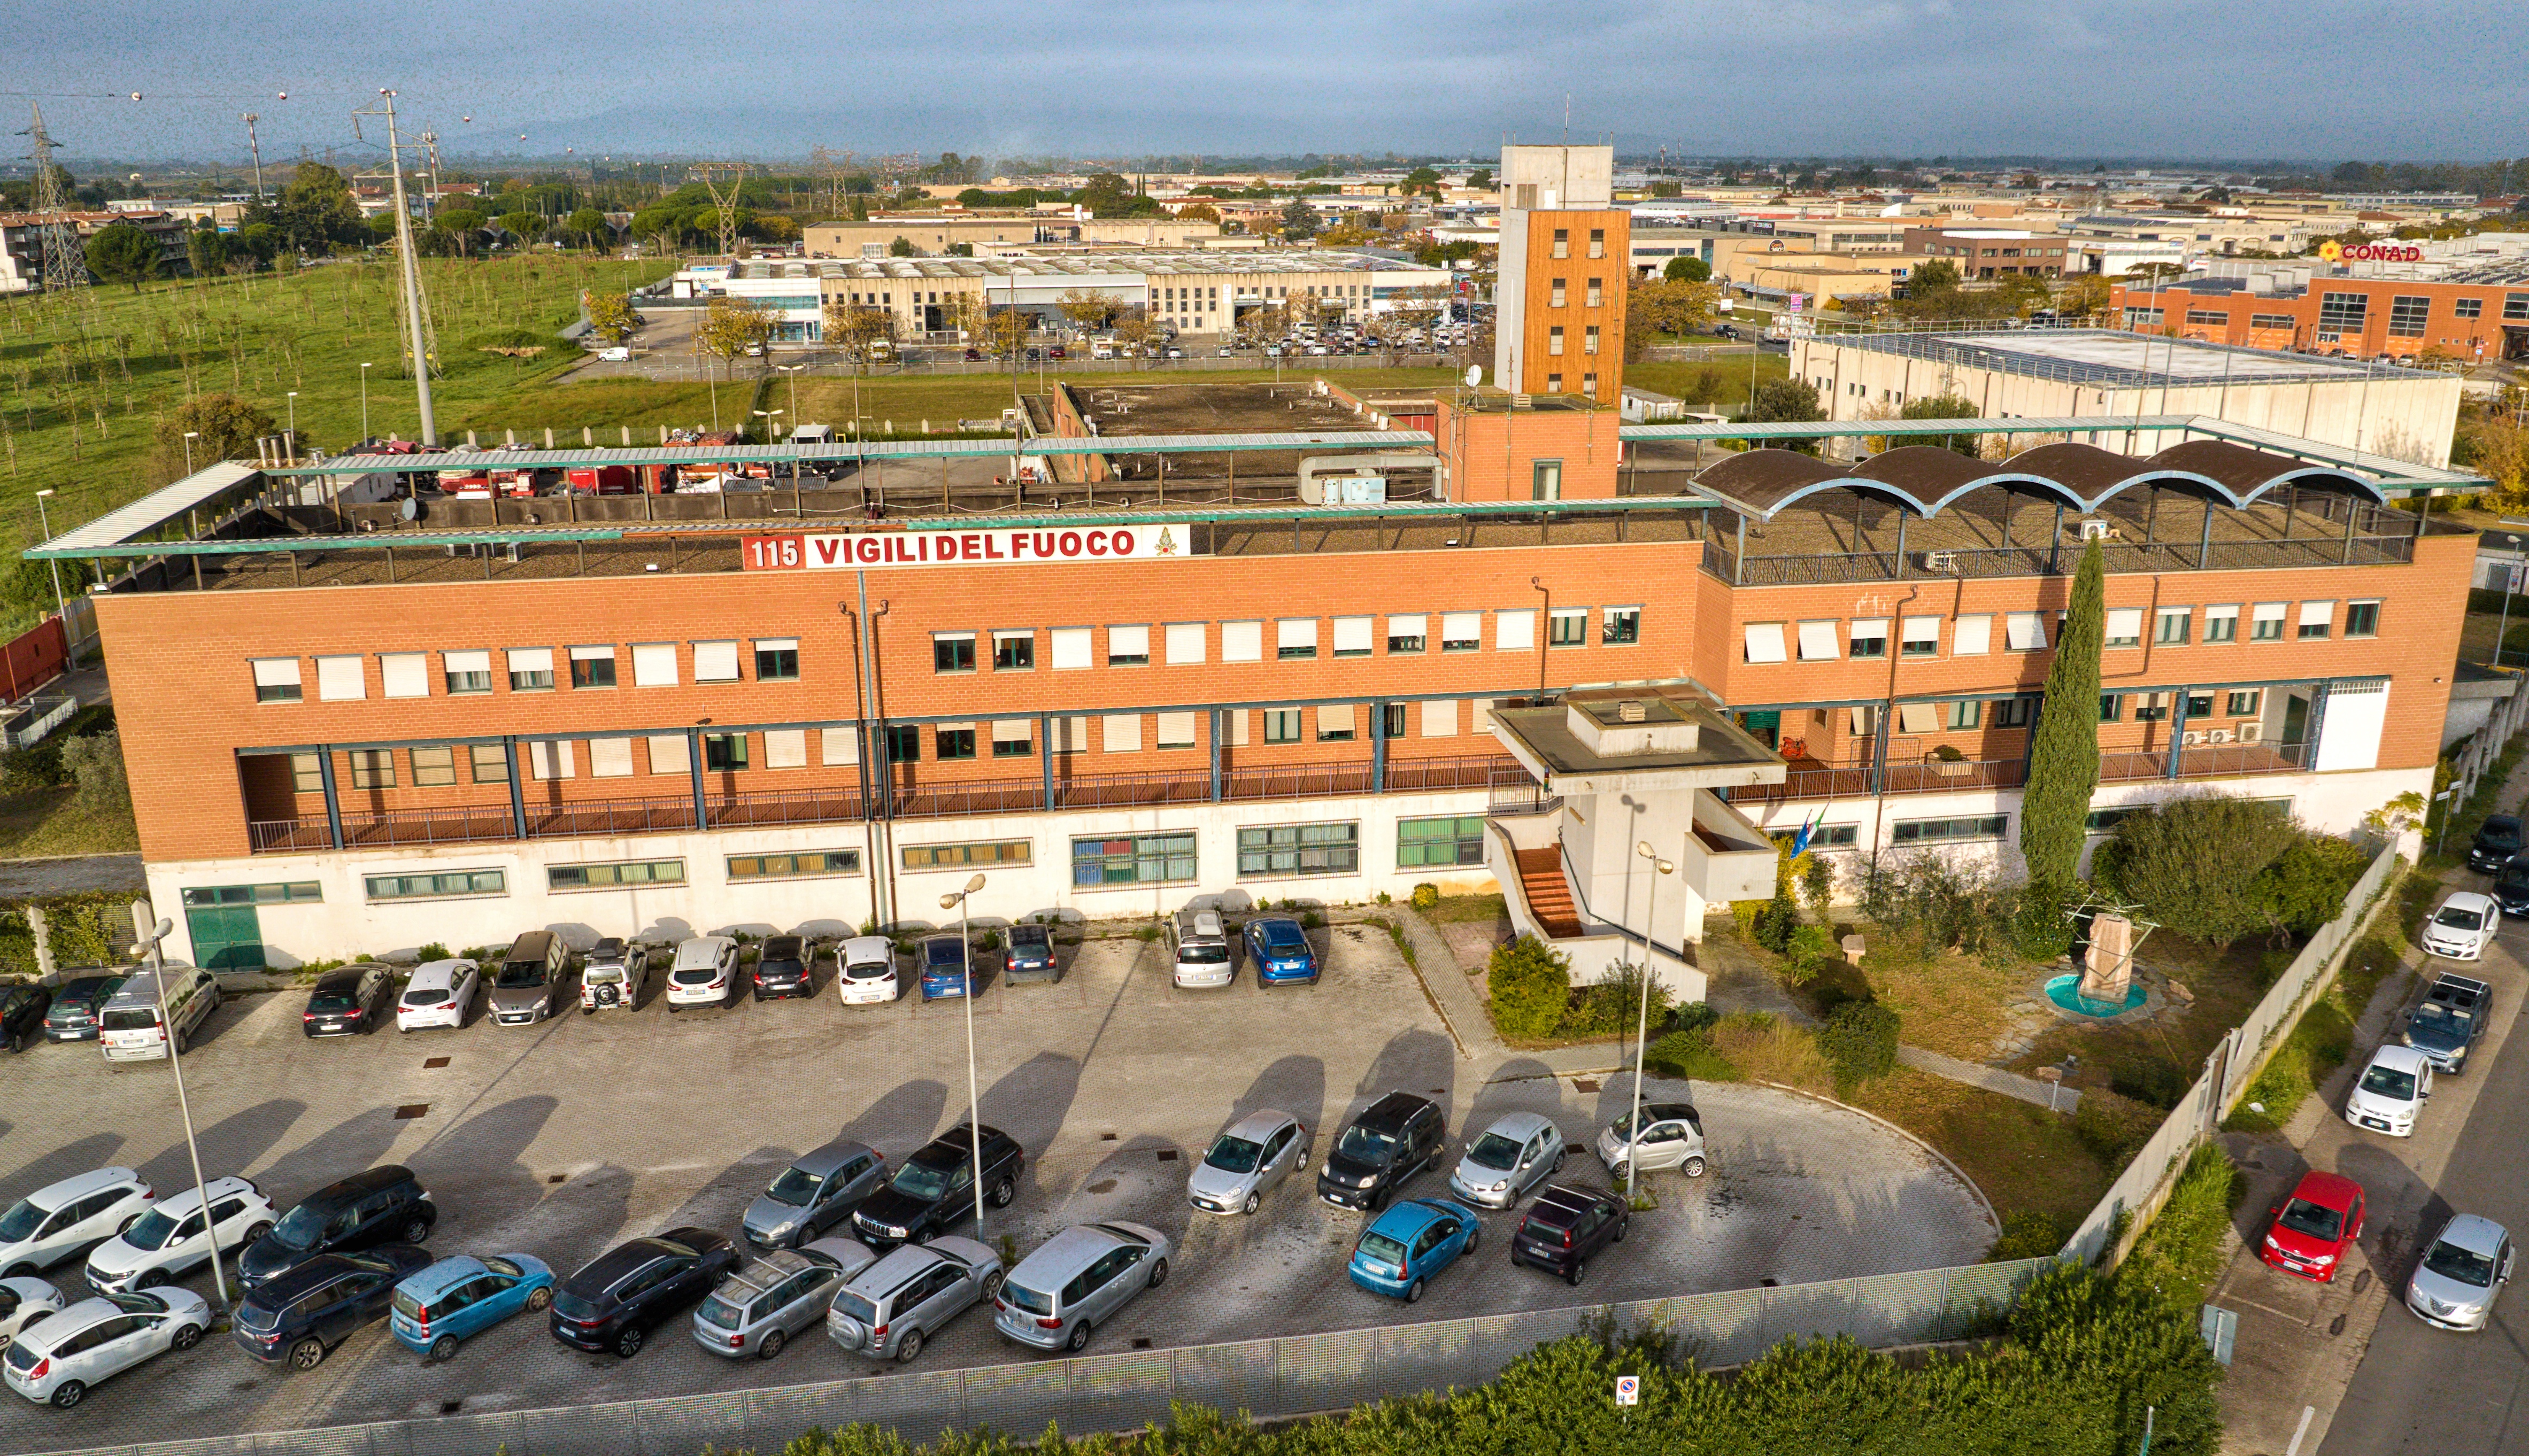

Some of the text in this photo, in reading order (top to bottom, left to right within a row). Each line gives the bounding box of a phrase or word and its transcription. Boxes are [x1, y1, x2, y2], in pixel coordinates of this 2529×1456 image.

[2342, 245, 2420, 262] CONAD
[752, 530, 1135, 567] 115 VIGILI DEL FUOCO
